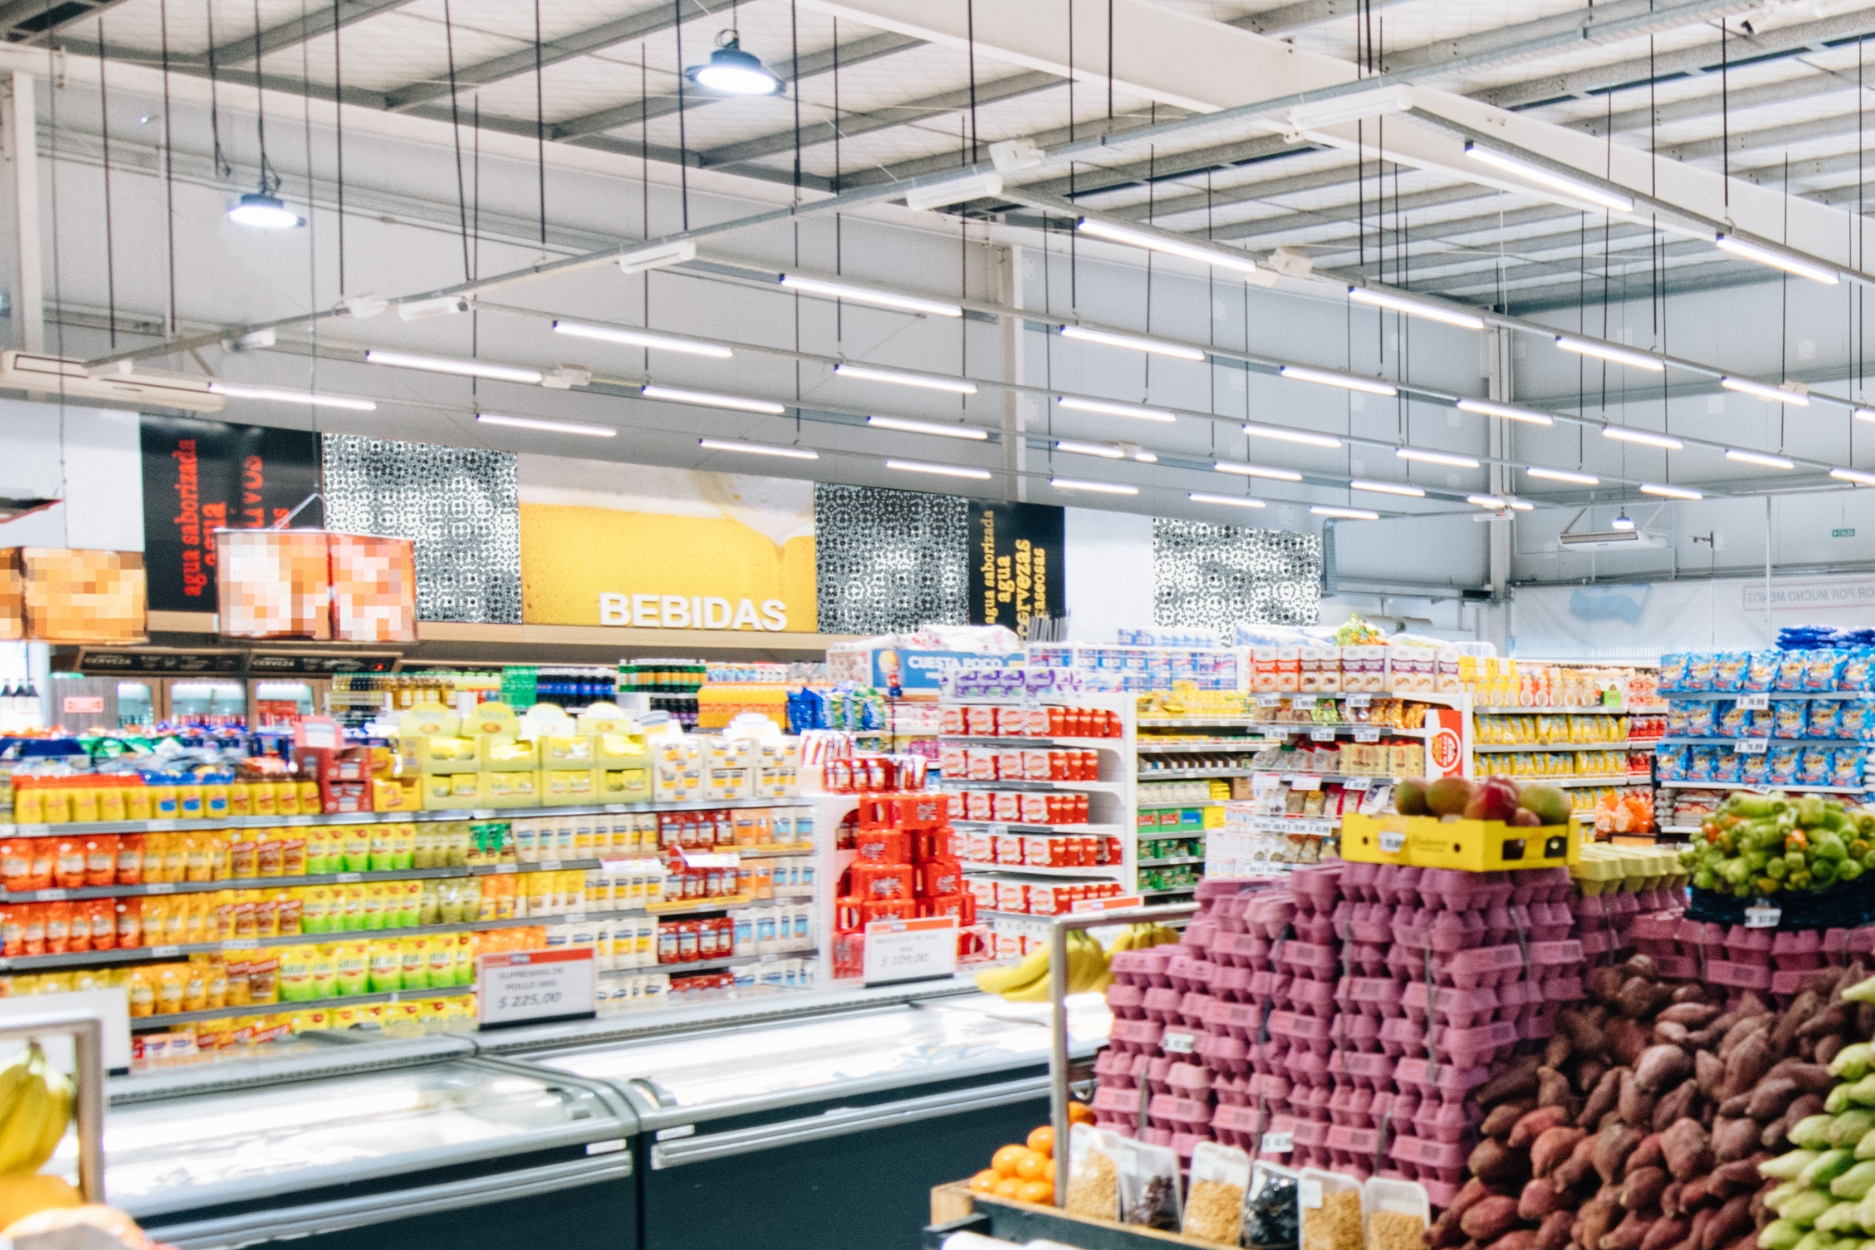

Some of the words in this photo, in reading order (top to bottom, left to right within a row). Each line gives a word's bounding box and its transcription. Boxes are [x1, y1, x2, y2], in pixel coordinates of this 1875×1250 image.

[172, 439, 199, 545] saborizada
[980, 510, 995, 587] saborizada
[183, 549, 207, 596] agua
[997, 555, 1015, 603] agua
[1015, 539, 1031, 636] cervezas
[600, 592, 788, 632] BEBIDAS
[985, 590, 998, 624] agua
[85, 657, 132, 666] CERVEZA
[252, 659, 295, 667] CERVEZA
[908, 655, 962, 669] CUESTA
[962, 658, 1002, 668] POCO
[497, 995, 507, 1010] $
